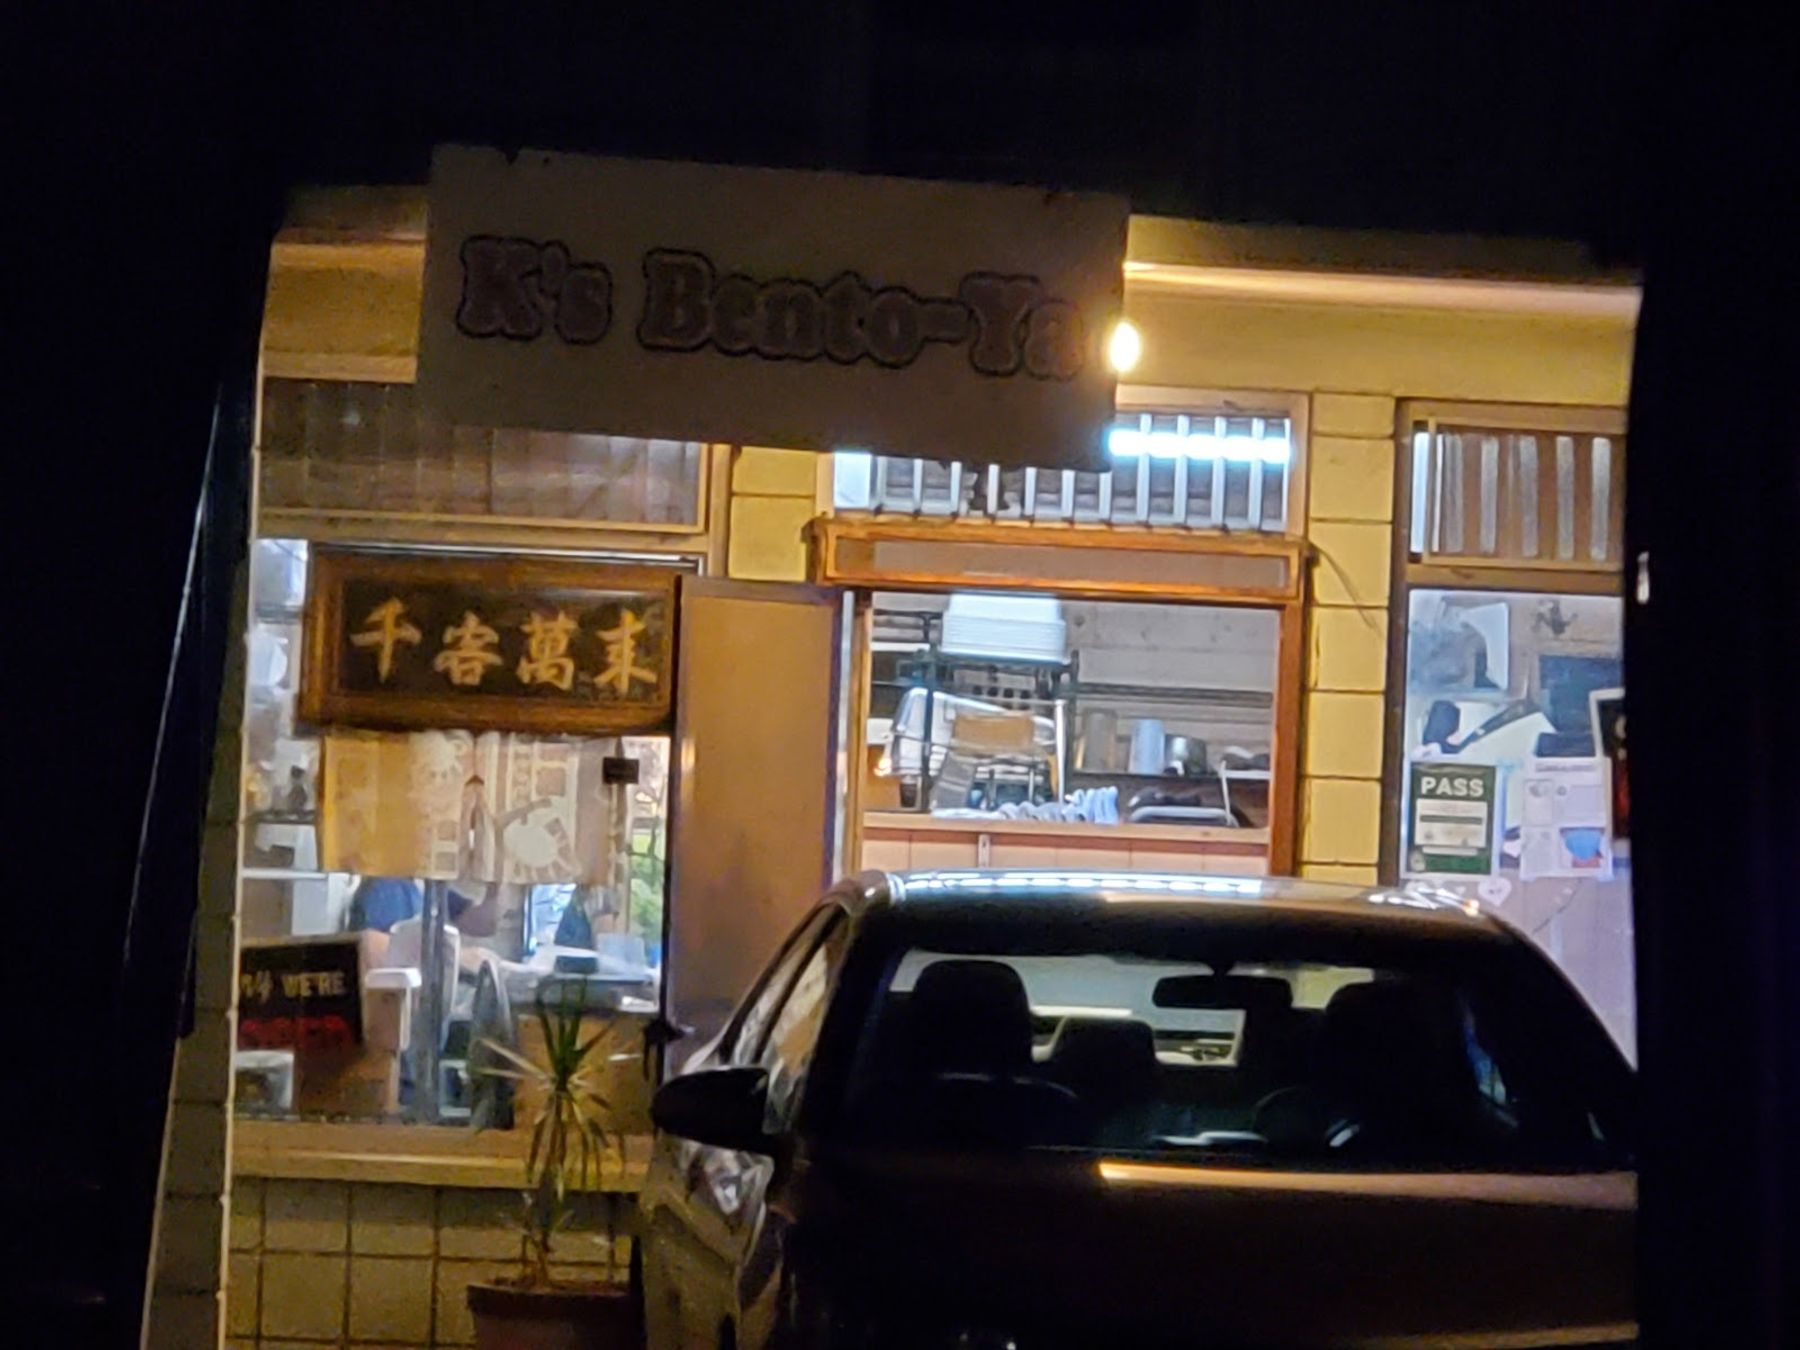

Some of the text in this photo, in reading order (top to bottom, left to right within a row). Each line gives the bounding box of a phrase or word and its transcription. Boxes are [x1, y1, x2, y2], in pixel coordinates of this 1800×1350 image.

[456, 234, 1087, 381] K's Bento-Ya
[1420, 775, 1485, 798] PASS
